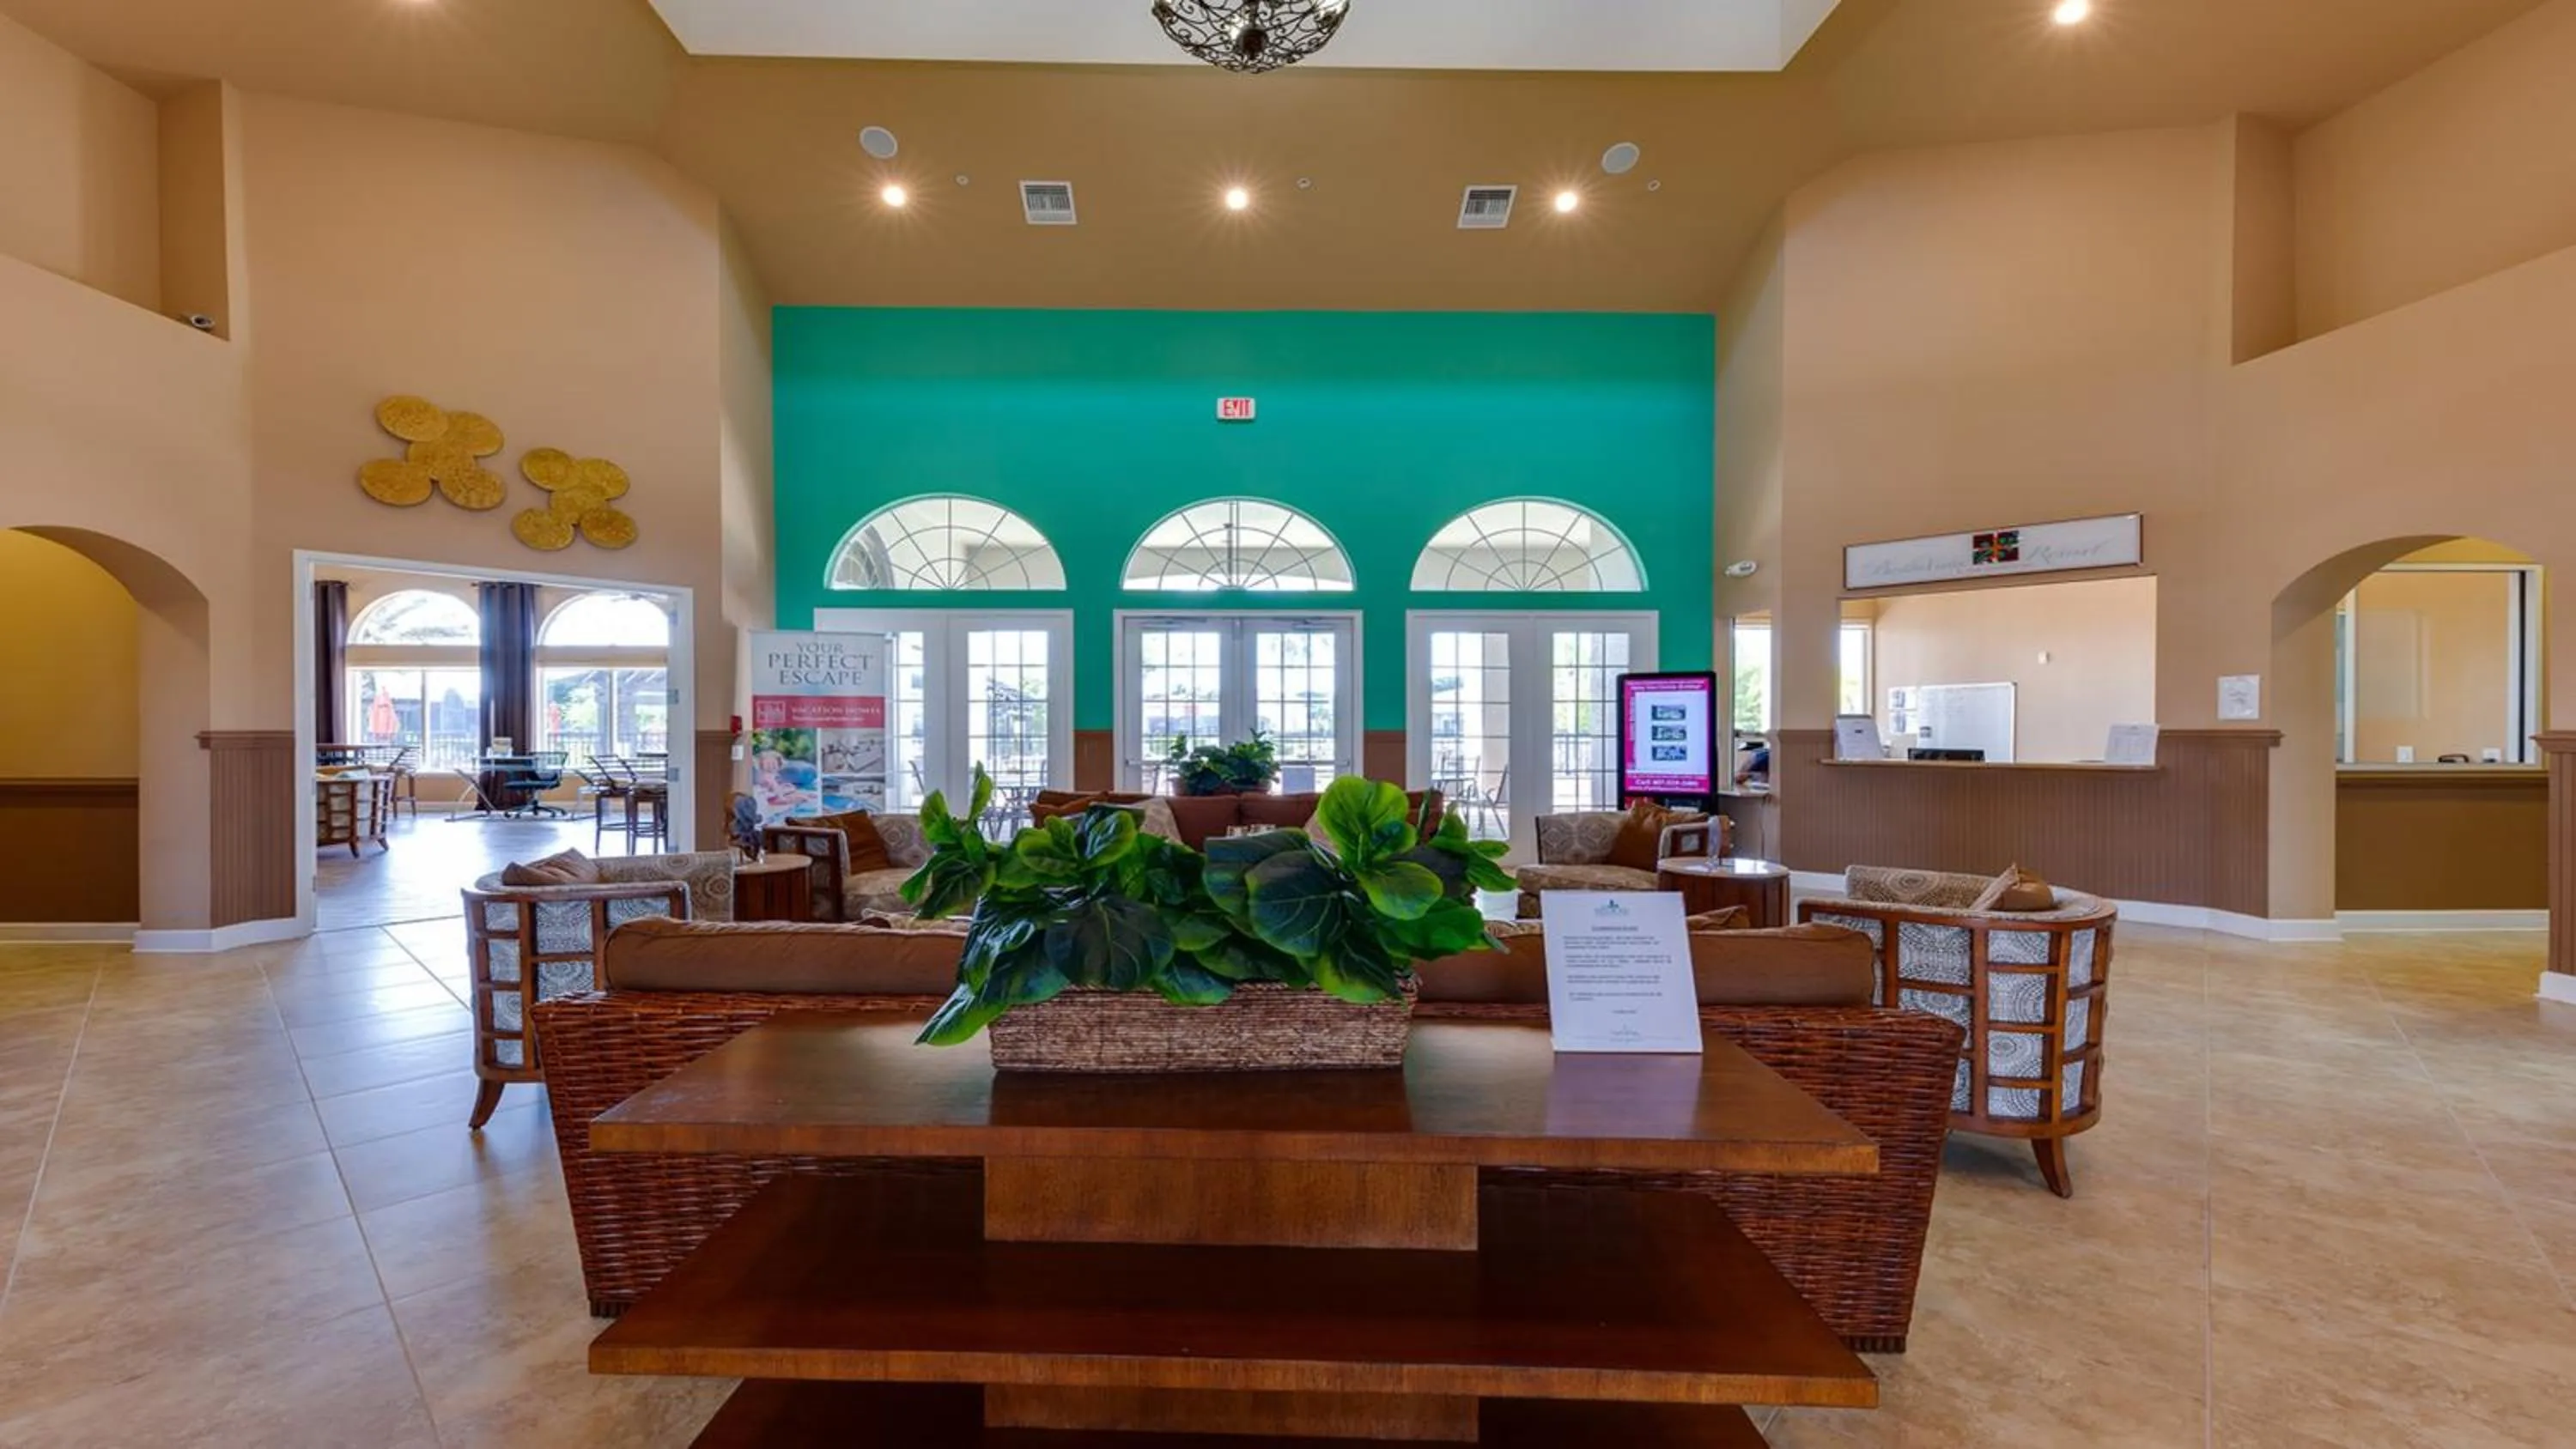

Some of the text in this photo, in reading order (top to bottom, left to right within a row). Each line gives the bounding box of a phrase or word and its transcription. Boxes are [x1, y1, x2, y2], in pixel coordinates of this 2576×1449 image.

[1223, 398, 1251, 416] EXIT
[796, 642, 844, 653] YOUR
[769, 653, 873, 670] PERFECT
[780, 670, 864, 686] ESCAPE
